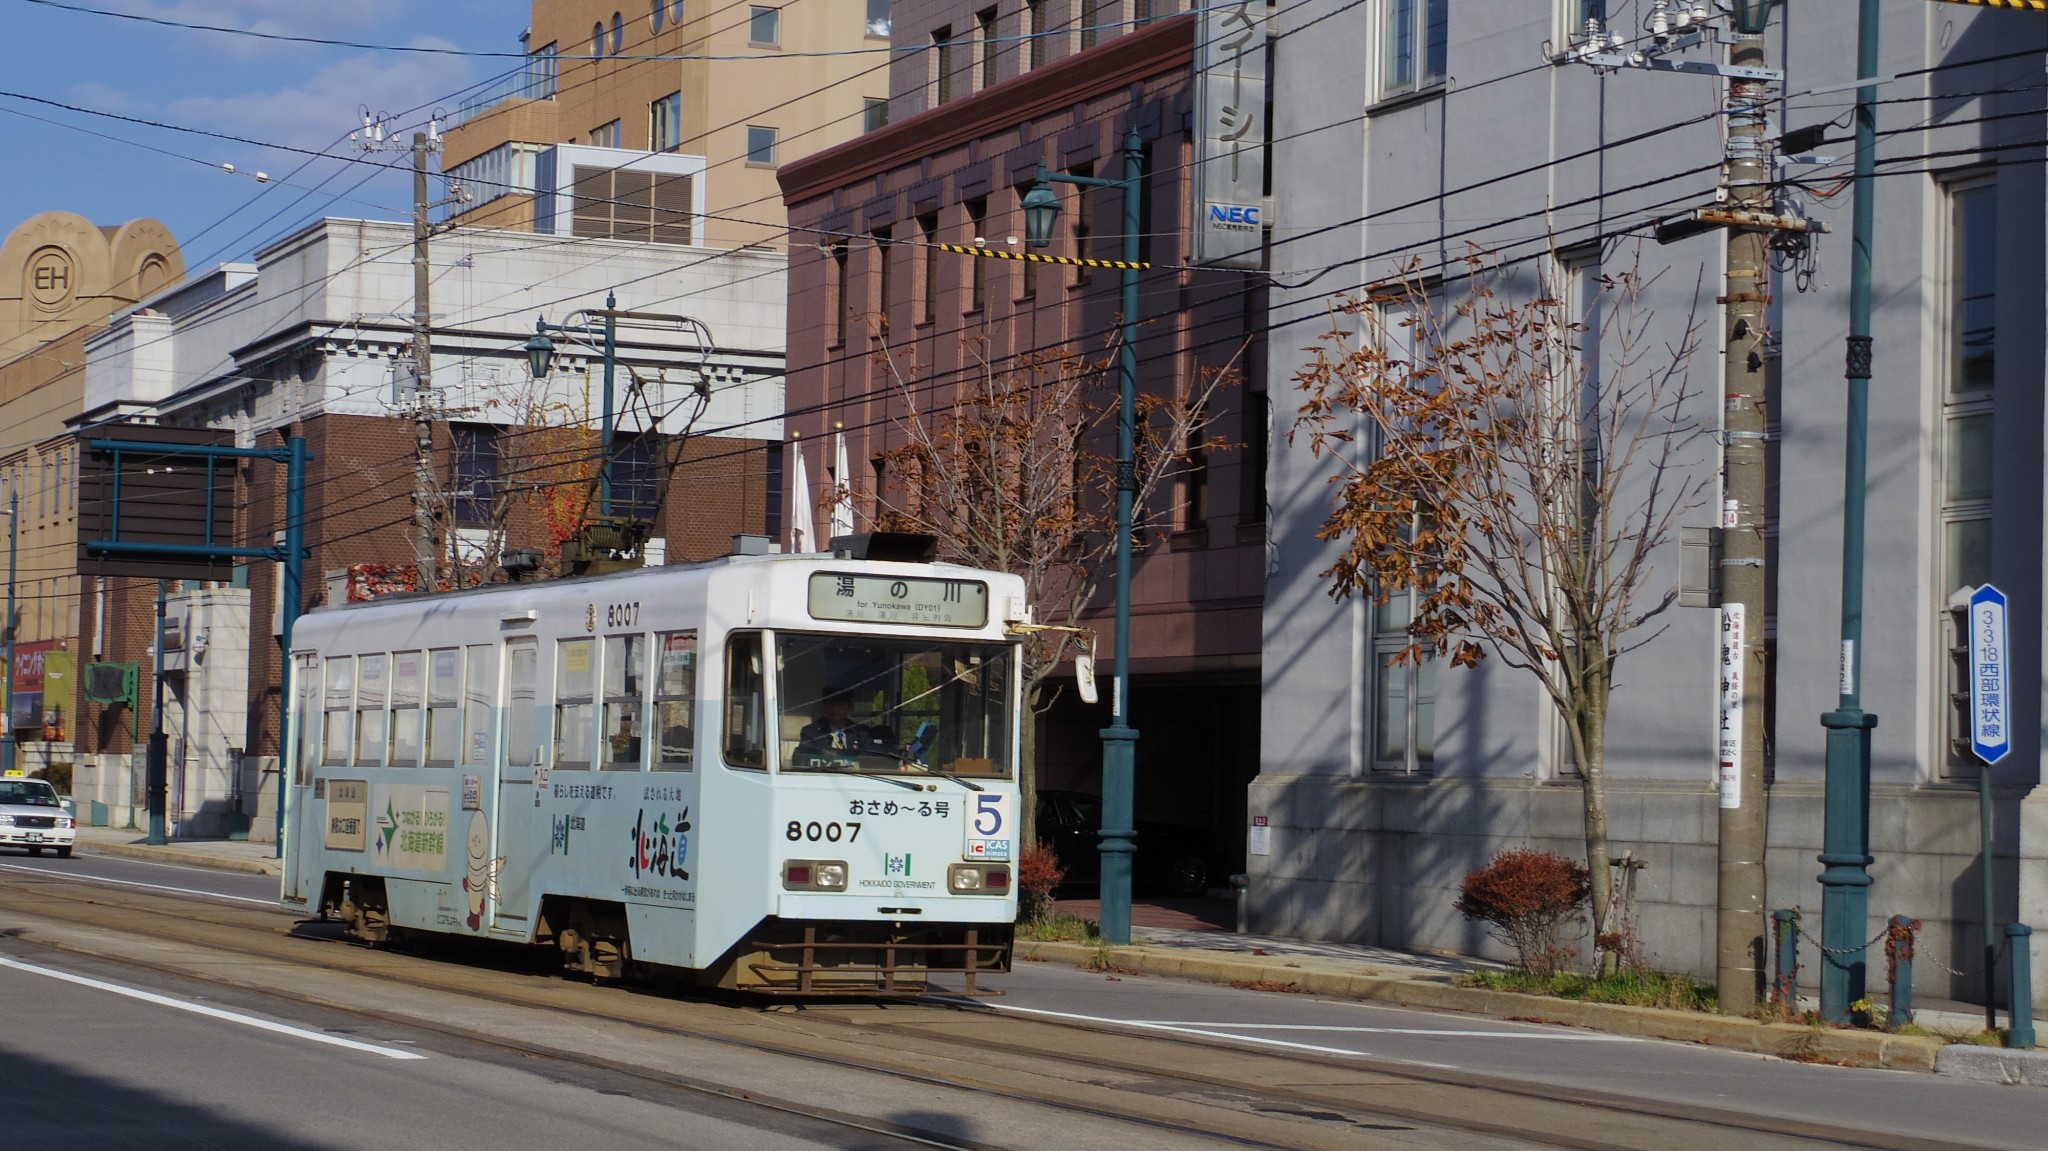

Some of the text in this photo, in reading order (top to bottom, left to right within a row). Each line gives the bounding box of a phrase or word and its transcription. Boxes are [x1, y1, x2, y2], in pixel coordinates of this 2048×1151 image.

[1209, 205, 1260, 225] NEC
[35, 266, 69, 290] EH
[836, 576, 961, 603] 湯の川
[607, 602, 640, 627] 8007
[857, 600, 940, 612] for Yunokawa (DY01)
[643, 786, 682, 801] 試される大地
[974, 794, 1003, 835] 5
[630, 805, 691, 881] 北海道
[786, 820, 862, 843] 8007
[986, 840, 1008, 850] ICAS
[859, 879, 937, 889] HOKKAIDO GOVERNMENT
